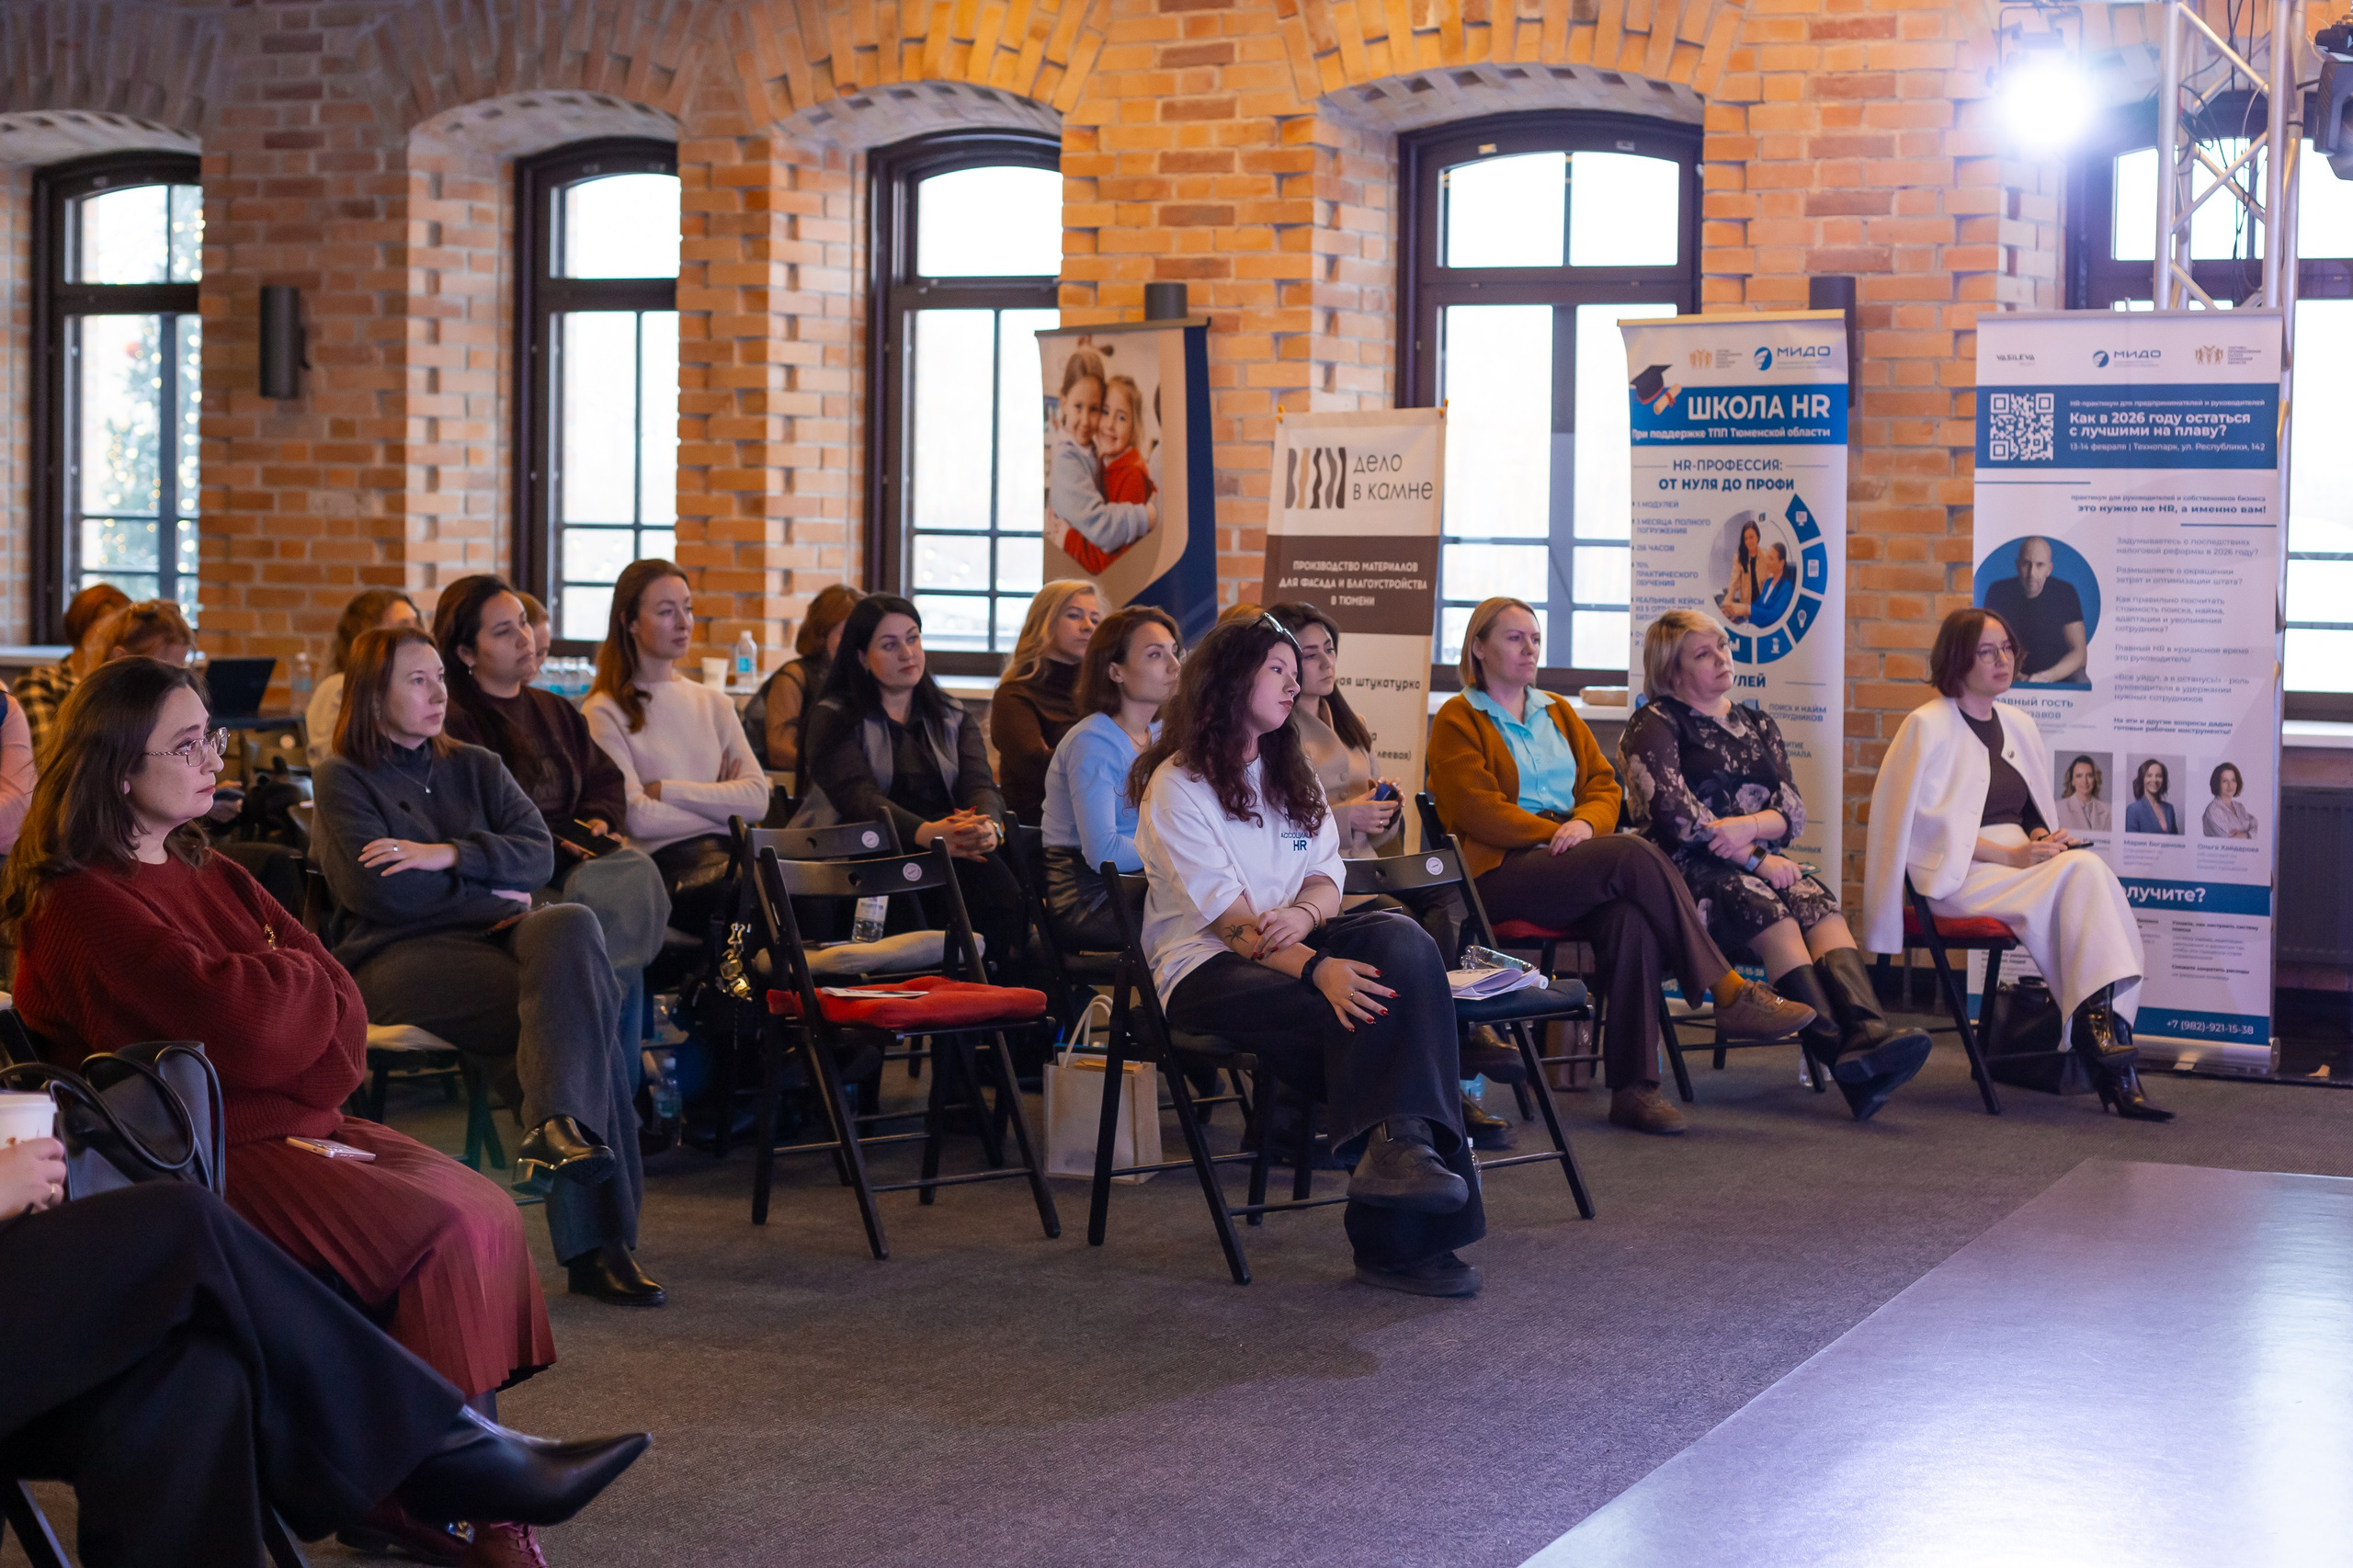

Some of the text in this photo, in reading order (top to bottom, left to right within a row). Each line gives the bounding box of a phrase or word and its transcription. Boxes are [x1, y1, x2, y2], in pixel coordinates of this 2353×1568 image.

[1777, 346, 1831, 357] МИДО
[2114, 349, 2162, 358] МИДО
[1688, 394, 1831, 420] ШКОЛА HR
[2070, 411, 2251, 426] Как в 2026 году остаться
[1631, 426, 1831, 440] При поддержке ТПП Тюменской области
[2069, 424, 2227, 438] с лучшими на плаву?
[2090, 442, 2127, 451] февраля
[2251, 442, 2266, 451] 142
[1353, 453, 1403, 473] дело
[1673, 460, 1783, 471] HR-ПРОФЕССИЯ:
[1353, 482, 1433, 500] в камне
[1658, 478, 1794, 492] ОТ НУЛЯ ДО ПРОФИ
[2099, 506, 2138, 514] нужно
[2158, 505, 2178, 514] HR,
[2241, 506, 2267, 514] вам!
[1292, 560, 1419, 572] ПРОИЗВОДСТВО МАТЕРИАЛОВ
[1279, 577, 1427, 589] ДЛЯ ФАСАДА И БЛАГОУСТРОЙСТВА
[1330, 596, 1375, 606] В ТЮМЕНИ
[1356, 678, 1421, 691] штукатурка
[2041, 699, 2074, 708] гость
[1377, 750, 1412, 761] леевая)
[1293, 839, 1307, 851] HR
[2121, 886, 2206, 903] лучите?
